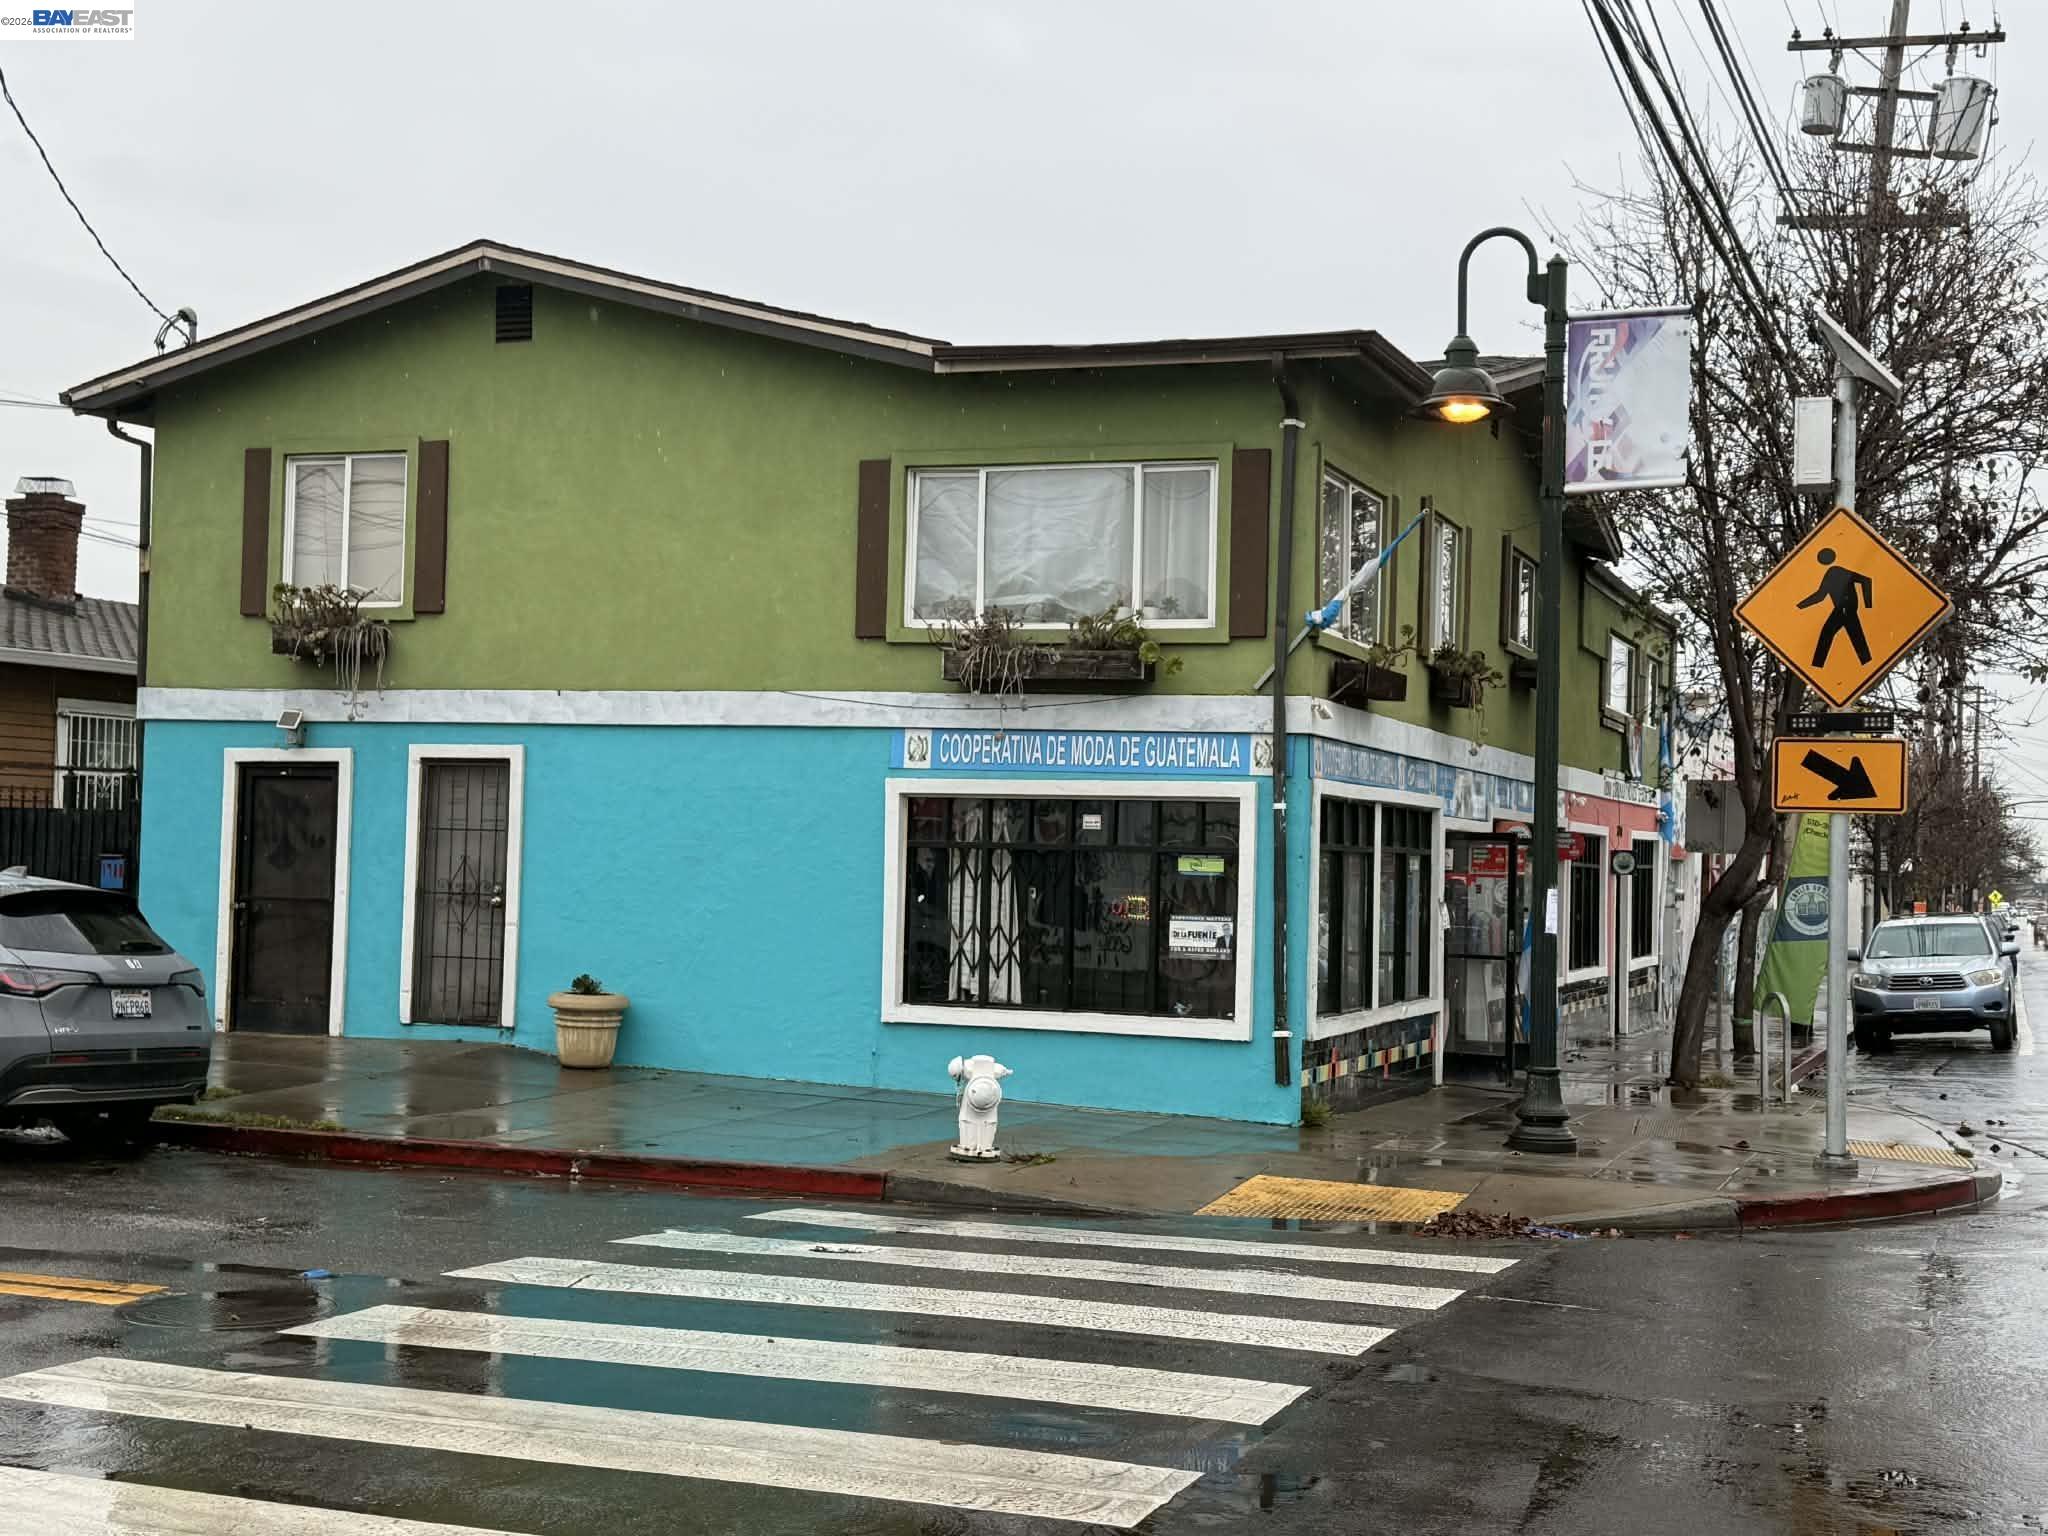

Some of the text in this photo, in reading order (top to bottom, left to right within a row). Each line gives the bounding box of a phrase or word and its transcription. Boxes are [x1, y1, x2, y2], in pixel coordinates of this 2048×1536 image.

[940, 734, 1240, 768] COOPERATIVA DE MODA DE GUATEMALA
